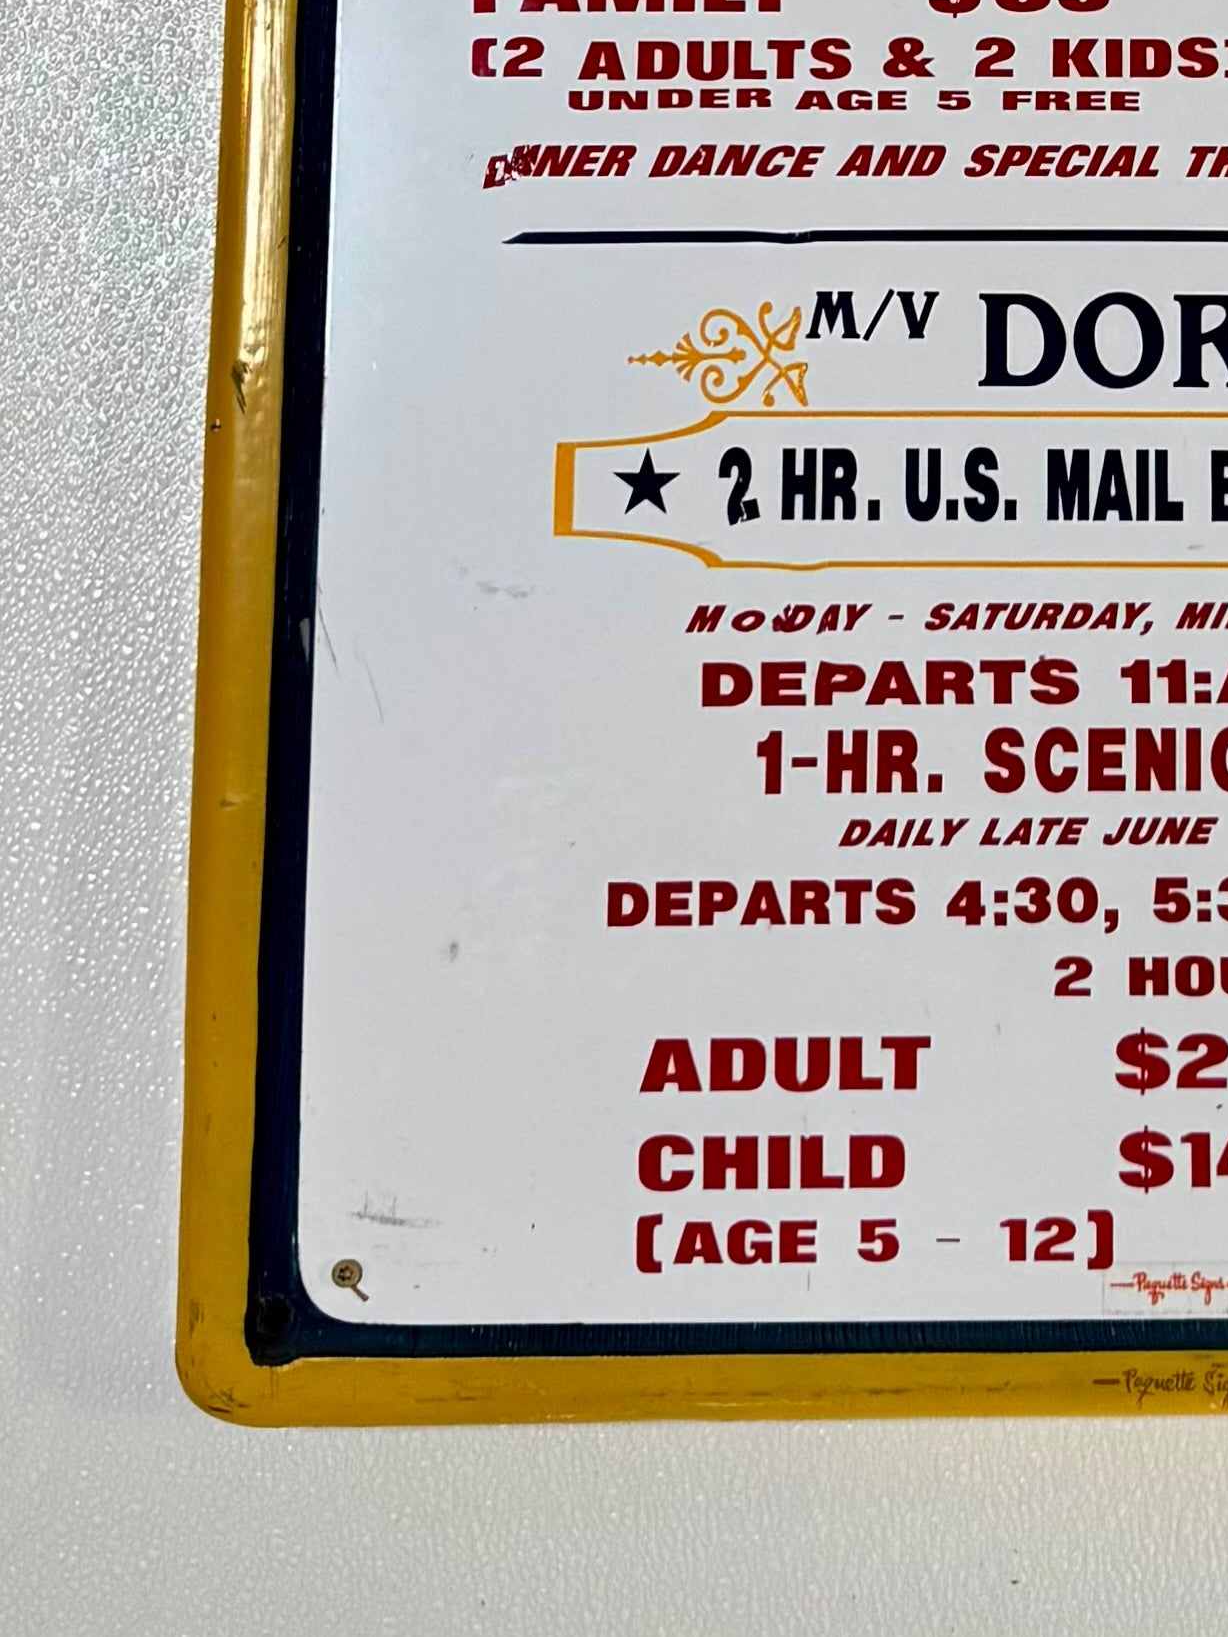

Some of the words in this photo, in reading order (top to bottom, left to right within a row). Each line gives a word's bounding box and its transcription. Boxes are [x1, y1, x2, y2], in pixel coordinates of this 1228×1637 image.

[579, 38, 852, 81] ADULTS
[883, 38, 935, 78] &
[974, 38, 1016, 78] 2
[567, 88, 771, 112] UNDER
[797, 91, 903, 110] AGE
[937, 90, 971, 112] 5
[1002, 91, 1140, 112] FREE
[649, 144, 824, 178] DANCE
[838, 145, 946, 178] AND
[965, 145, 1157, 177] SPECIAL
[806, 289, 939, 341] M/V
[719, 447, 760, 525] 2
[782, 449, 880, 520] HR.
[906, 447, 1017, 522] U.S.
[1047, 449, 1183, 521] MAIL
[925, 602, 1154, 635] SATURDAY,
[701, 658, 1080, 707] DEPARTS
[757, 729, 943, 795] 1-HR.
[839, 818, 969, 847] DAILY
[979, 817, 1089, 846] LATE
[1103, 817, 1217, 845] JUNE
[607, 879, 916, 927] DEPARTS
[946, 877, 1121, 933] 4:30,
[1054, 956, 1092, 996] 2
[639, 1036, 931, 1092] ADULT
[638, 1135, 906, 1192] CHILD
[858, 1219, 899, 1263] 5
[1190, 1273, 1227, 1304] Signs
